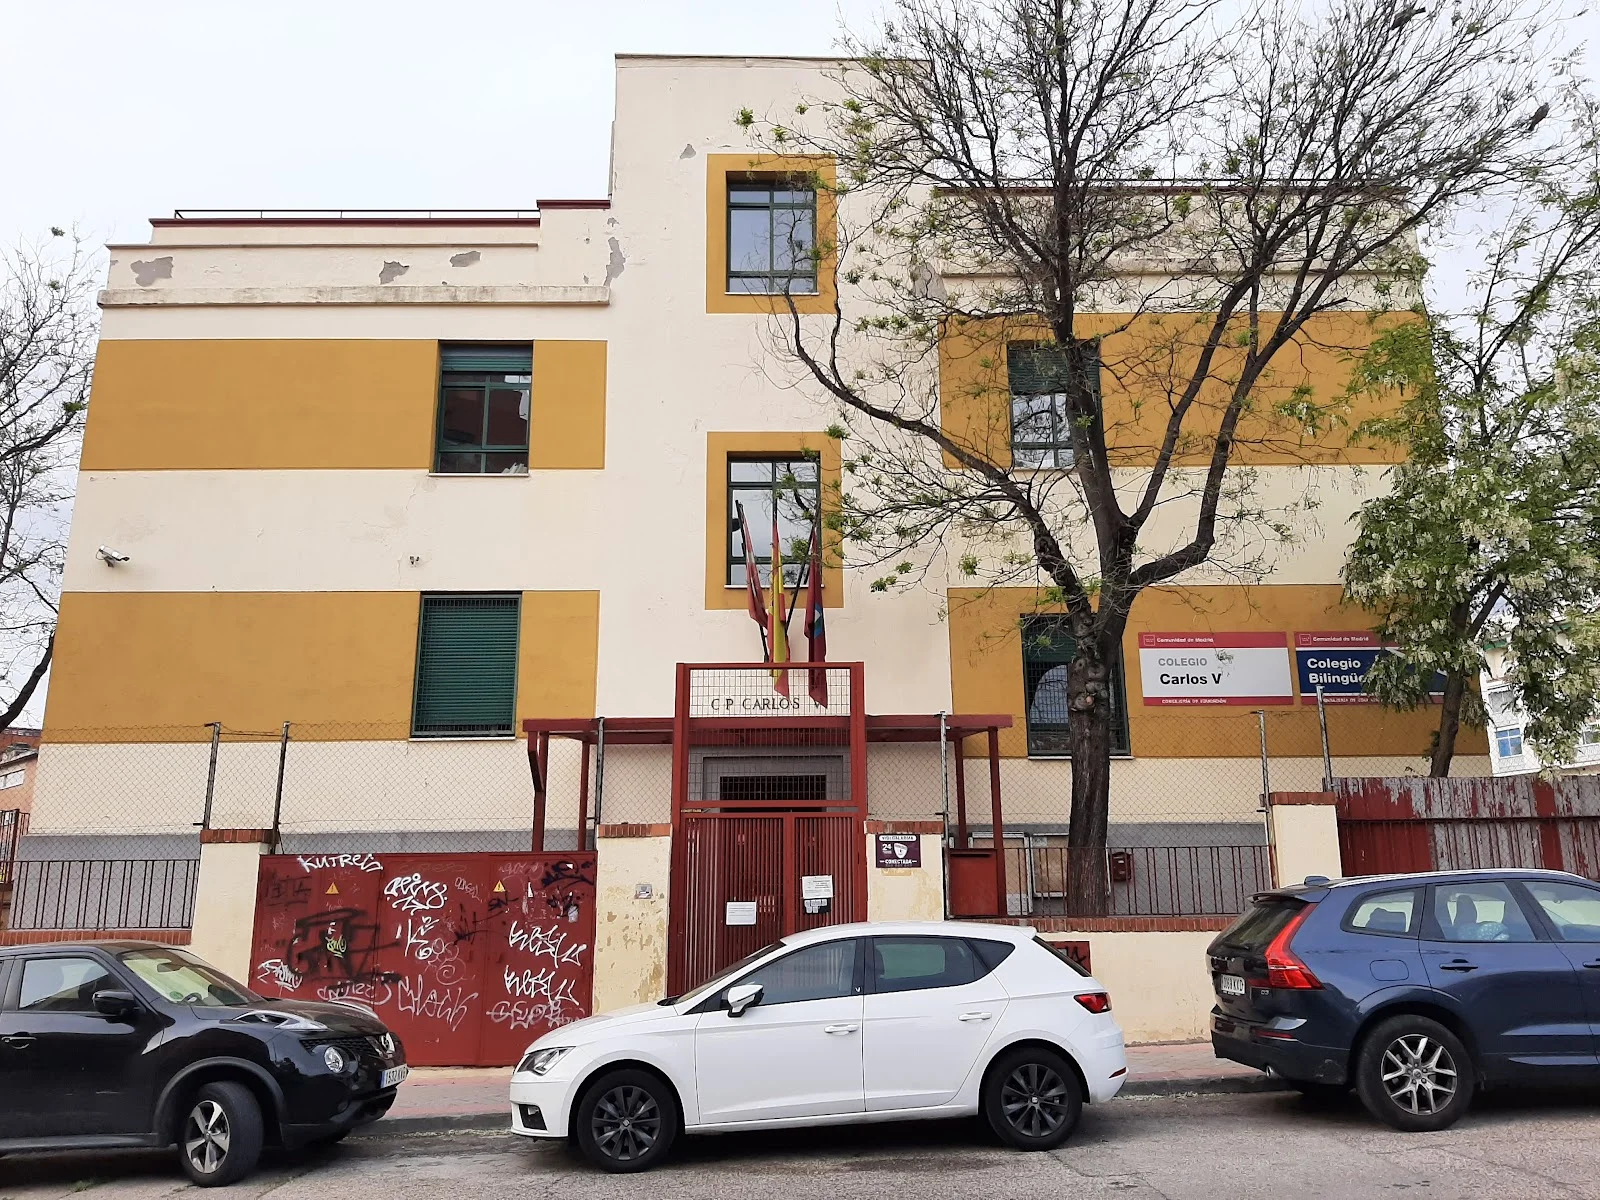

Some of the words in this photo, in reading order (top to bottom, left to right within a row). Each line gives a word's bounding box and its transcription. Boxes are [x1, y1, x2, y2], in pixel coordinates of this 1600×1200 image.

[1158, 657, 1208, 667] COLEGIO
[1307, 657, 1361, 671] Colegio
[1159, 673, 1208, 685] Carlos
[1211, 673, 1222, 685] V
[711, 698, 720, 710] C
[726, 698, 734, 710] P
[742, 698, 800, 710] CARLOS
[882, 843, 892, 851] 24
